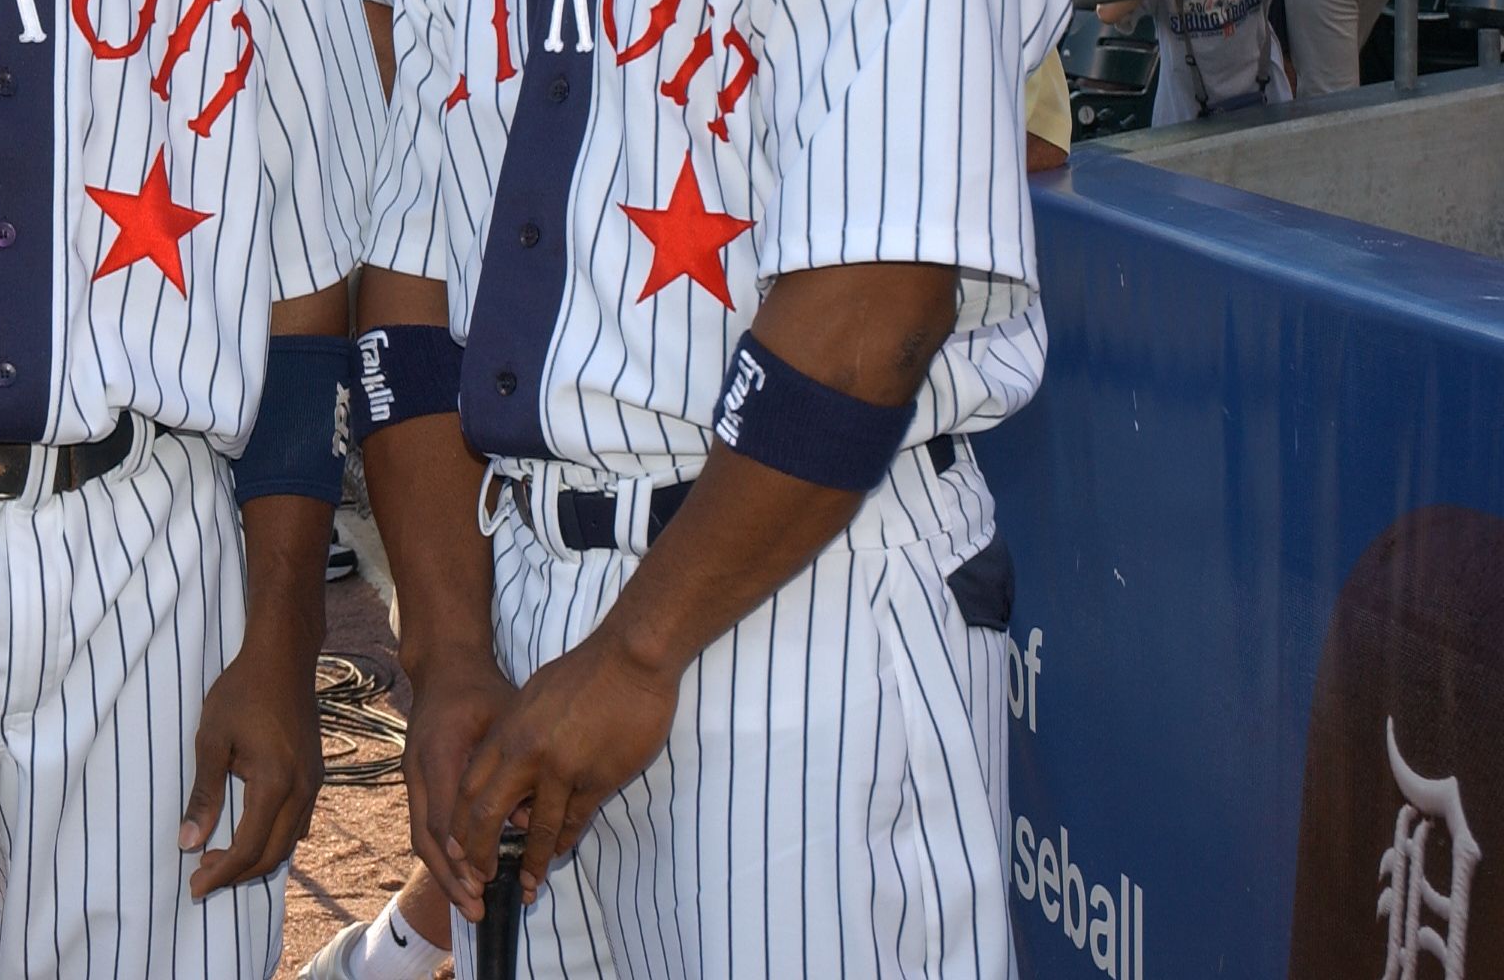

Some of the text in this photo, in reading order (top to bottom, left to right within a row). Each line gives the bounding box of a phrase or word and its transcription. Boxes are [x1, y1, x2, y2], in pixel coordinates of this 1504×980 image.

[357, 330, 395, 422] Franklin
[715, 349, 766, 447] Frankli
[1007, 627, 1042, 734] of
[1008, 809, 1143, 980] seball
